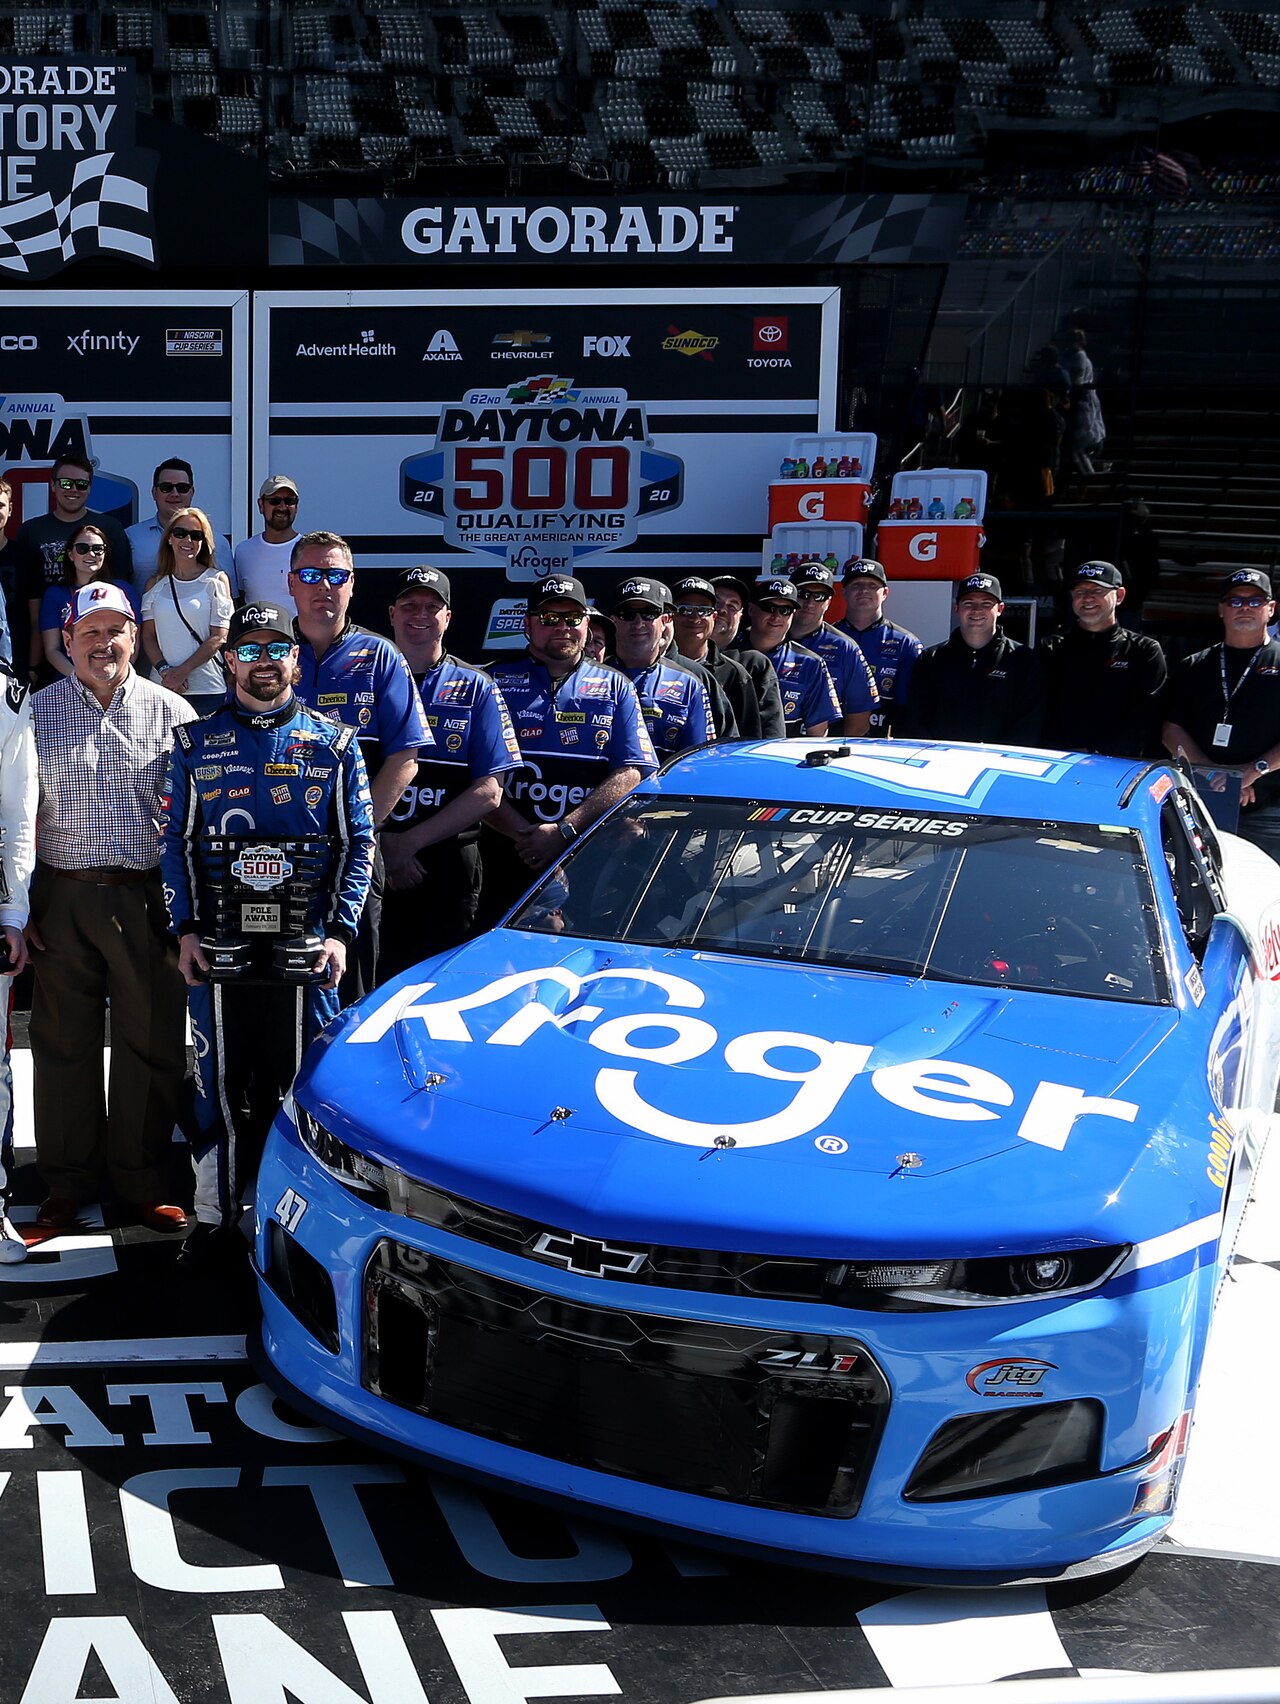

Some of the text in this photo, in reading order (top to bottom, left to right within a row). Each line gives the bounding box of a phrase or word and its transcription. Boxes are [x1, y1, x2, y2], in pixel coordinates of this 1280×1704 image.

[401, 205, 734, 254] GATORADE
[183, 331, 214, 339] NASCAR
[67, 329, 141, 356] xfinity
[173, 342, 215, 350] CUP SERIES
[583, 335, 631, 358] FOX
[663, 336, 718, 349] SUNOCO
[295, 343, 397, 357] AdventHealth
[490, 351, 554, 359] CHEVROLET
[422, 352, 464, 362] AXALTA
[747, 358, 792, 368] TOYOTA
[469, 394, 500, 404] 62ND
[581, 395, 621, 404] ANNUAL
[7, 402, 55, 413] ANNUAL
[440, 408, 645, 442] DAYTONA
[453, 447, 631, 510] 500
[413, 490, 435, 502] 20
[649, 489, 671, 500] 20
[798, 491, 825, 520] G
[456, 513, 625, 531] QUALIFYING
[458, 532, 619, 543] THE GREAT AMERICAN RACE
[908, 532, 938, 561] G
[510, 545, 569, 576] Kroger
[407, 569, 439, 583] Kroger
[542, 580, 574, 594] Kroger
[242, 607, 278, 624] Kroger
[319, 695, 346, 704] Cheerios
[354, 691, 375, 703] NOS
[251, 716, 275, 729] Kroger
[556, 712, 584, 722] Cheerios
[591, 714, 613, 726] NOS
[443, 718, 468, 730] NOS
[520, 728, 542, 738] GLAD
[202, 750, 239, 760] GOODYEAR
[266, 764, 296, 776] Cheerios
[305, 766, 332, 778] NOS
[788, 809, 968, 837] CUP SERIES
[241, 853, 284, 862] DAYTONA
[243, 861, 281, 875] 500
[250, 906, 272, 914] POLE
[244, 914, 278, 922] AWARD
[344, 965, 1141, 1152] Kroger
[276, 1187, 308, 1234] 47
[758, 1348, 858, 1373] ZL1
[984, 1364, 1048, 1386] jtg
